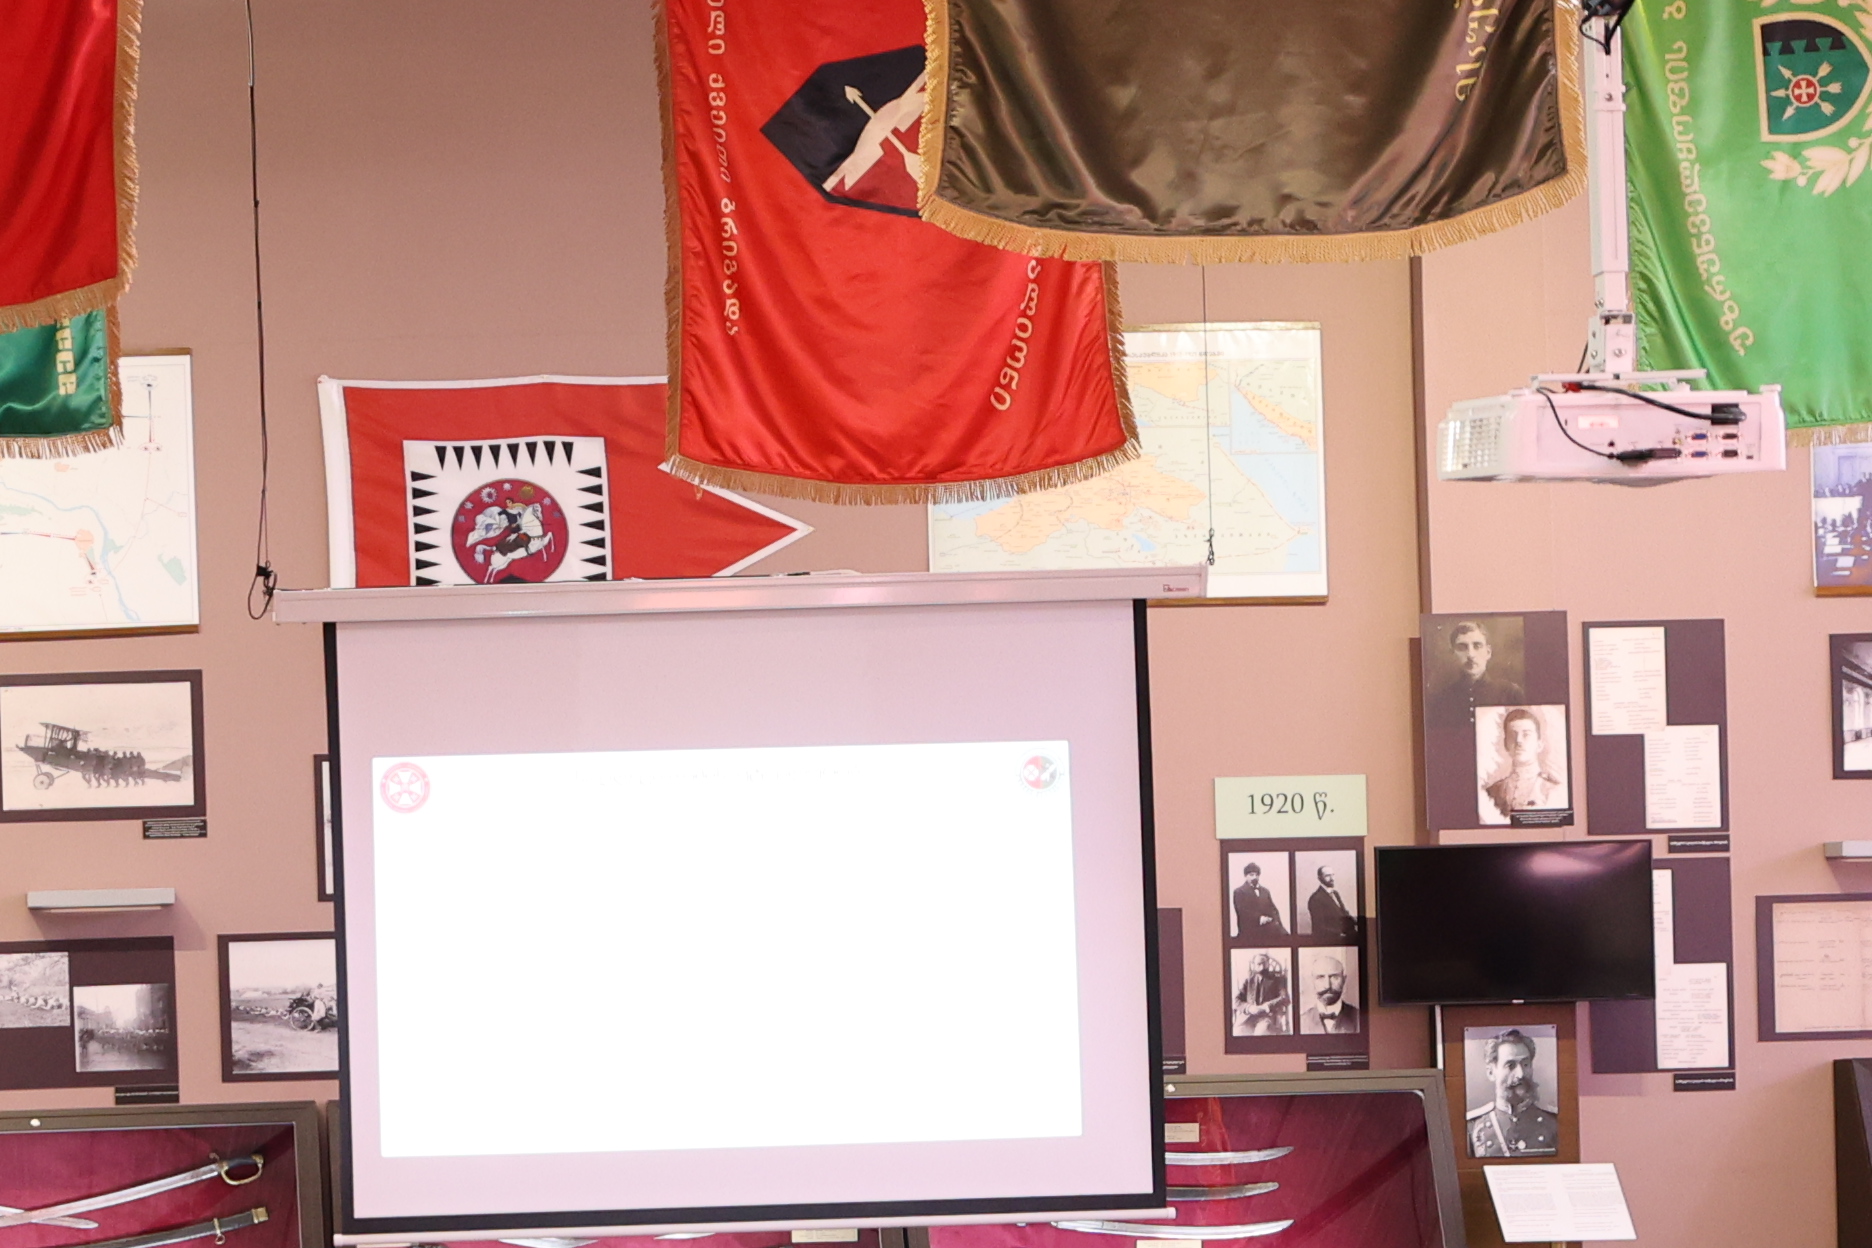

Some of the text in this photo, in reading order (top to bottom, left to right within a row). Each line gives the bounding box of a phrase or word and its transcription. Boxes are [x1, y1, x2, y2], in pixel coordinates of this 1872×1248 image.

[1664, 41, 1757, 356] უზრუნველყოფის
[1247, 791, 1335, 821] 1920 წ.
